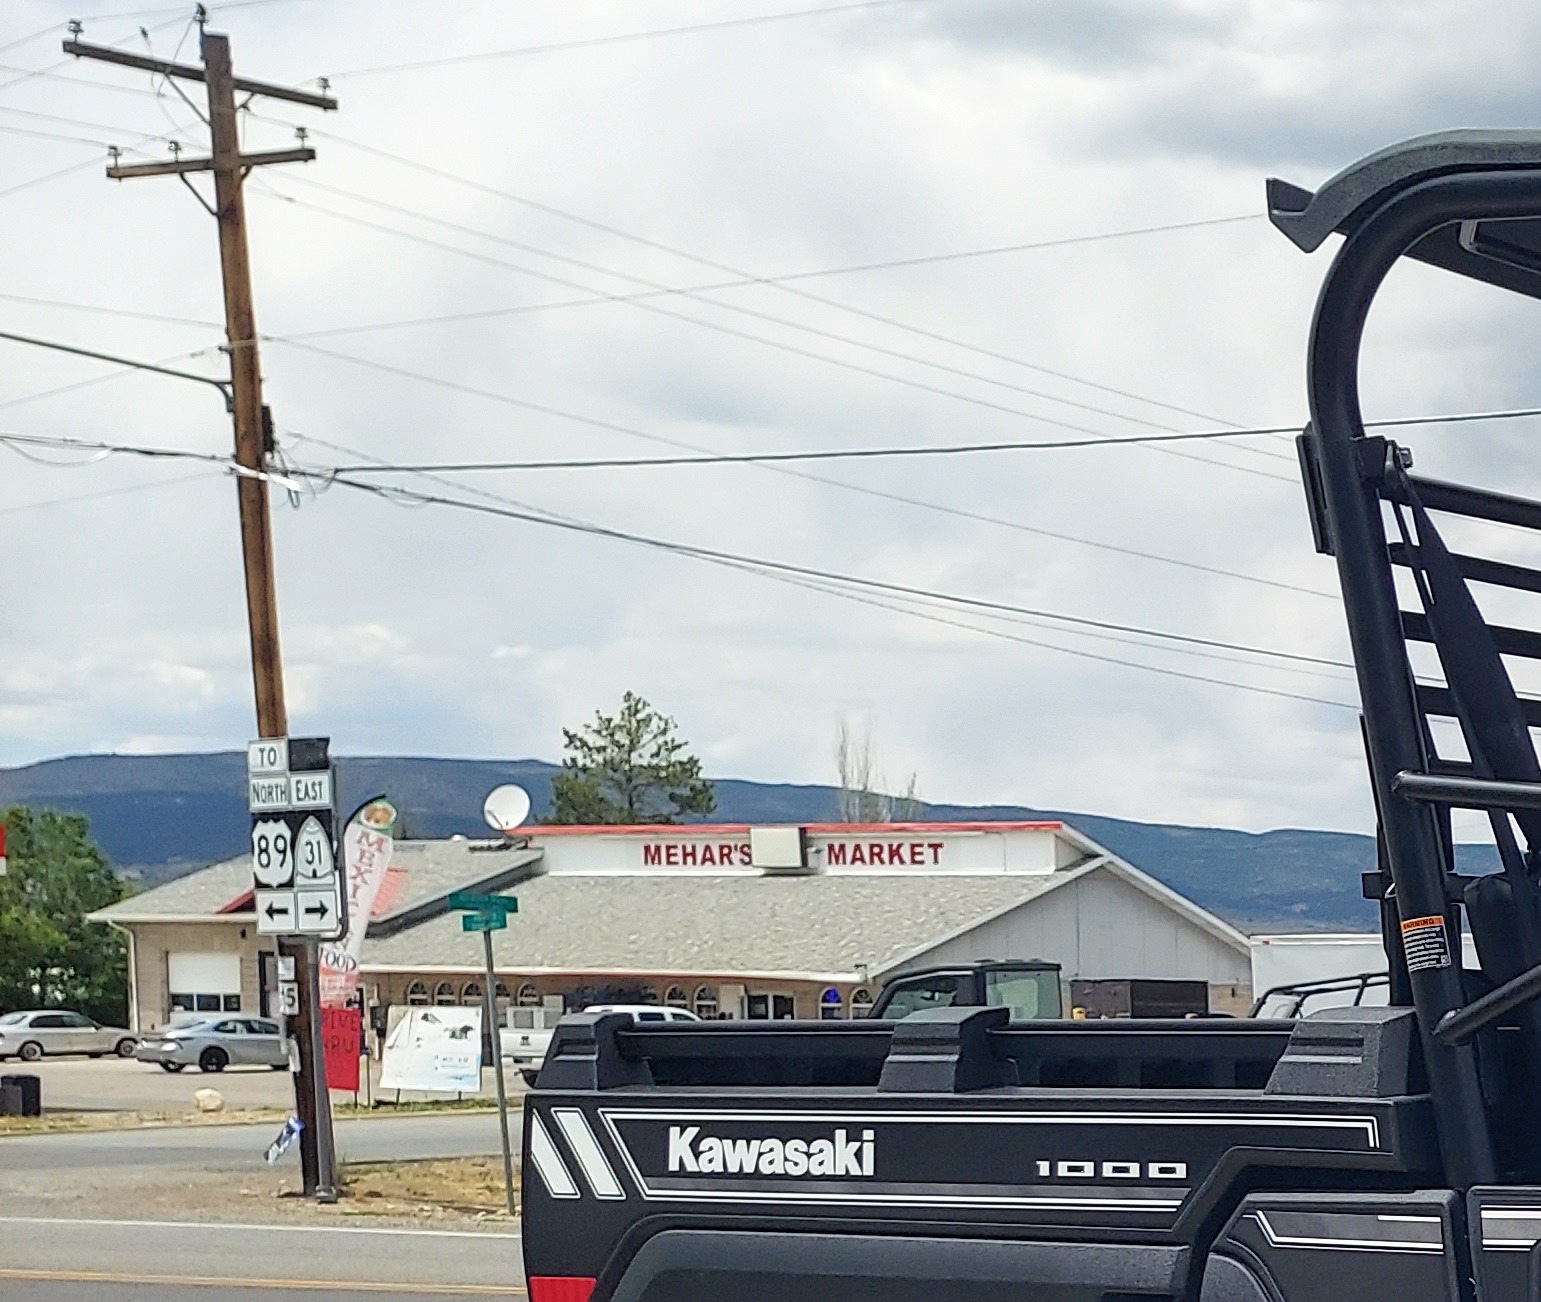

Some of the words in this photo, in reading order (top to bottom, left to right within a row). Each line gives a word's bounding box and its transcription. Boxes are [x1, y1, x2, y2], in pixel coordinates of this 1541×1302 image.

[258, 747, 277, 767] TO
[252, 781, 287, 803] NORTH
[295, 779, 323, 801] EAST
[257, 834, 287, 868] 89
[304, 840, 322, 865] 31
[643, 843, 752, 866] MEHAR'S
[827, 842, 944, 866] MARKET
[667, 1126, 875, 1177] Kawasaki
[1036, 1160, 1188, 1179] 1000
